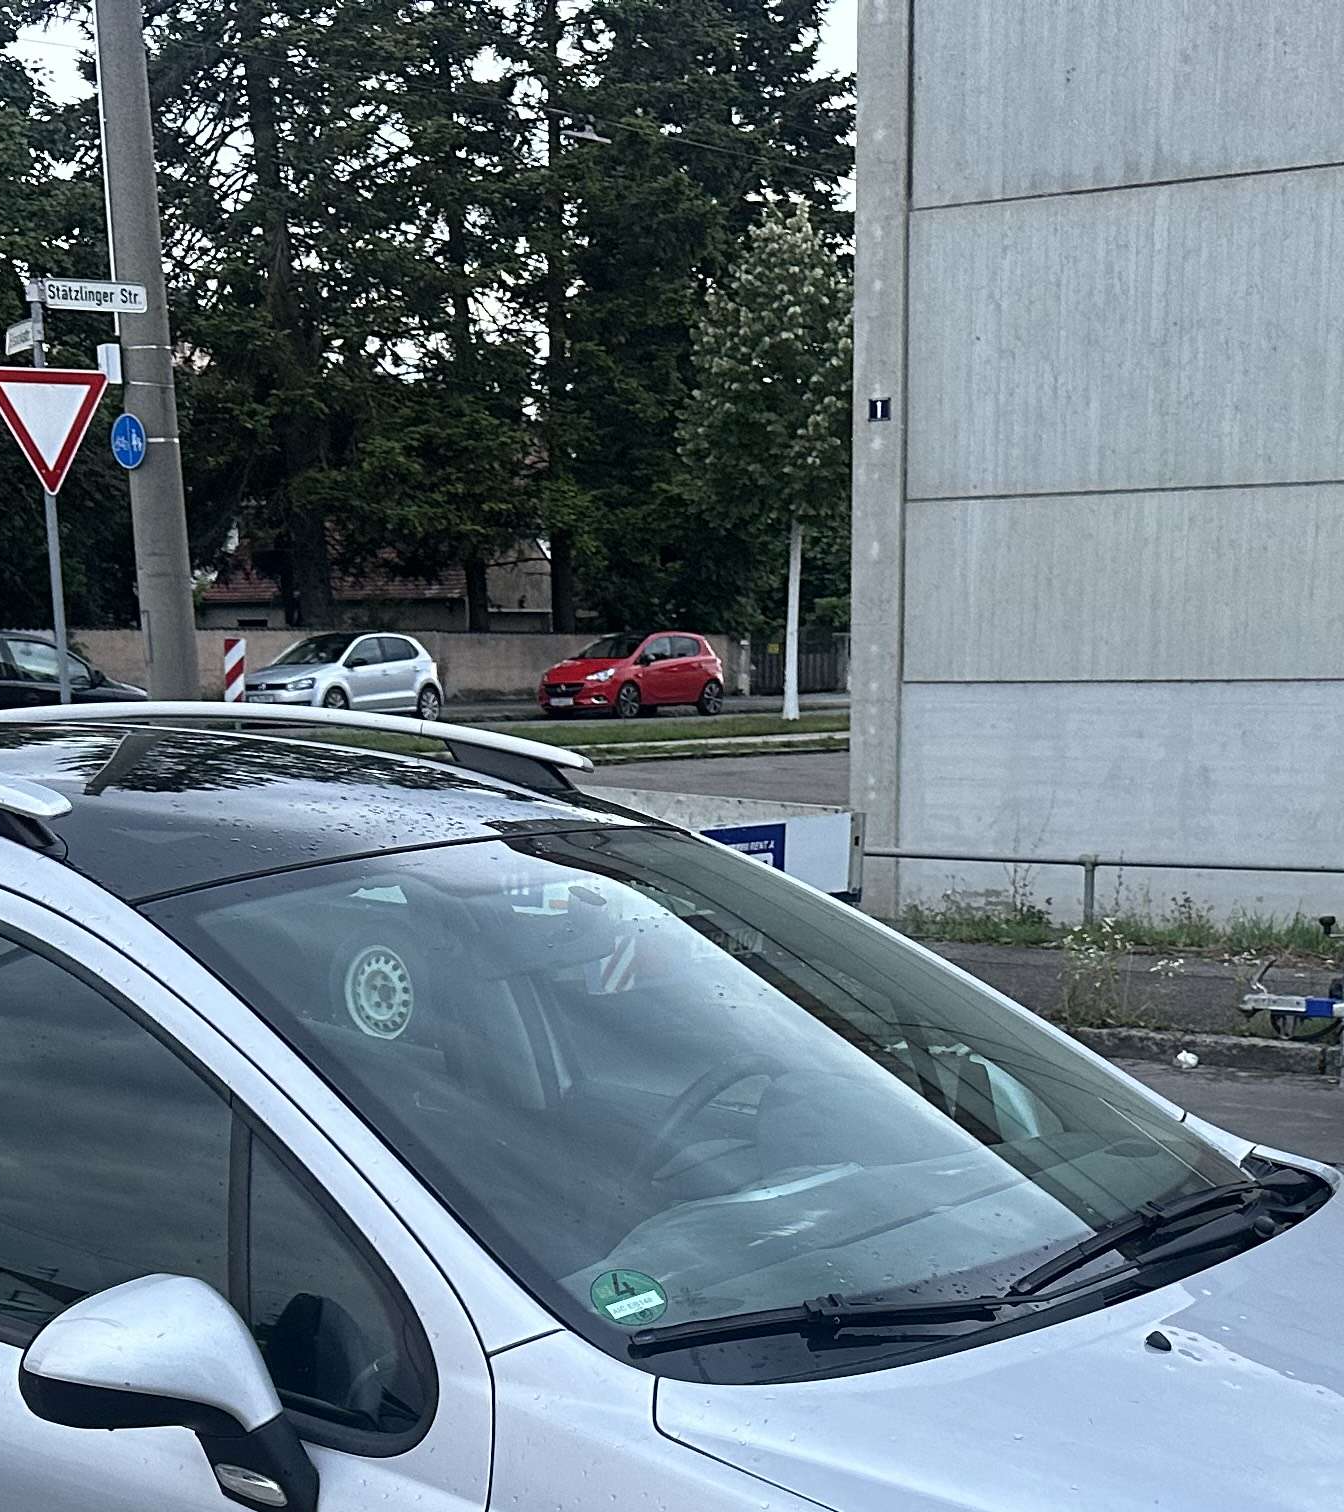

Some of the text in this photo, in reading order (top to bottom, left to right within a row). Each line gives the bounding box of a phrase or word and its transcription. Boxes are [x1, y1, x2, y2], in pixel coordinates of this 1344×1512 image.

[48, 284, 143, 306] Stätzlinger Str.
[876, 400, 882, 418] 1
[611, 1272, 636, 1296] 4
